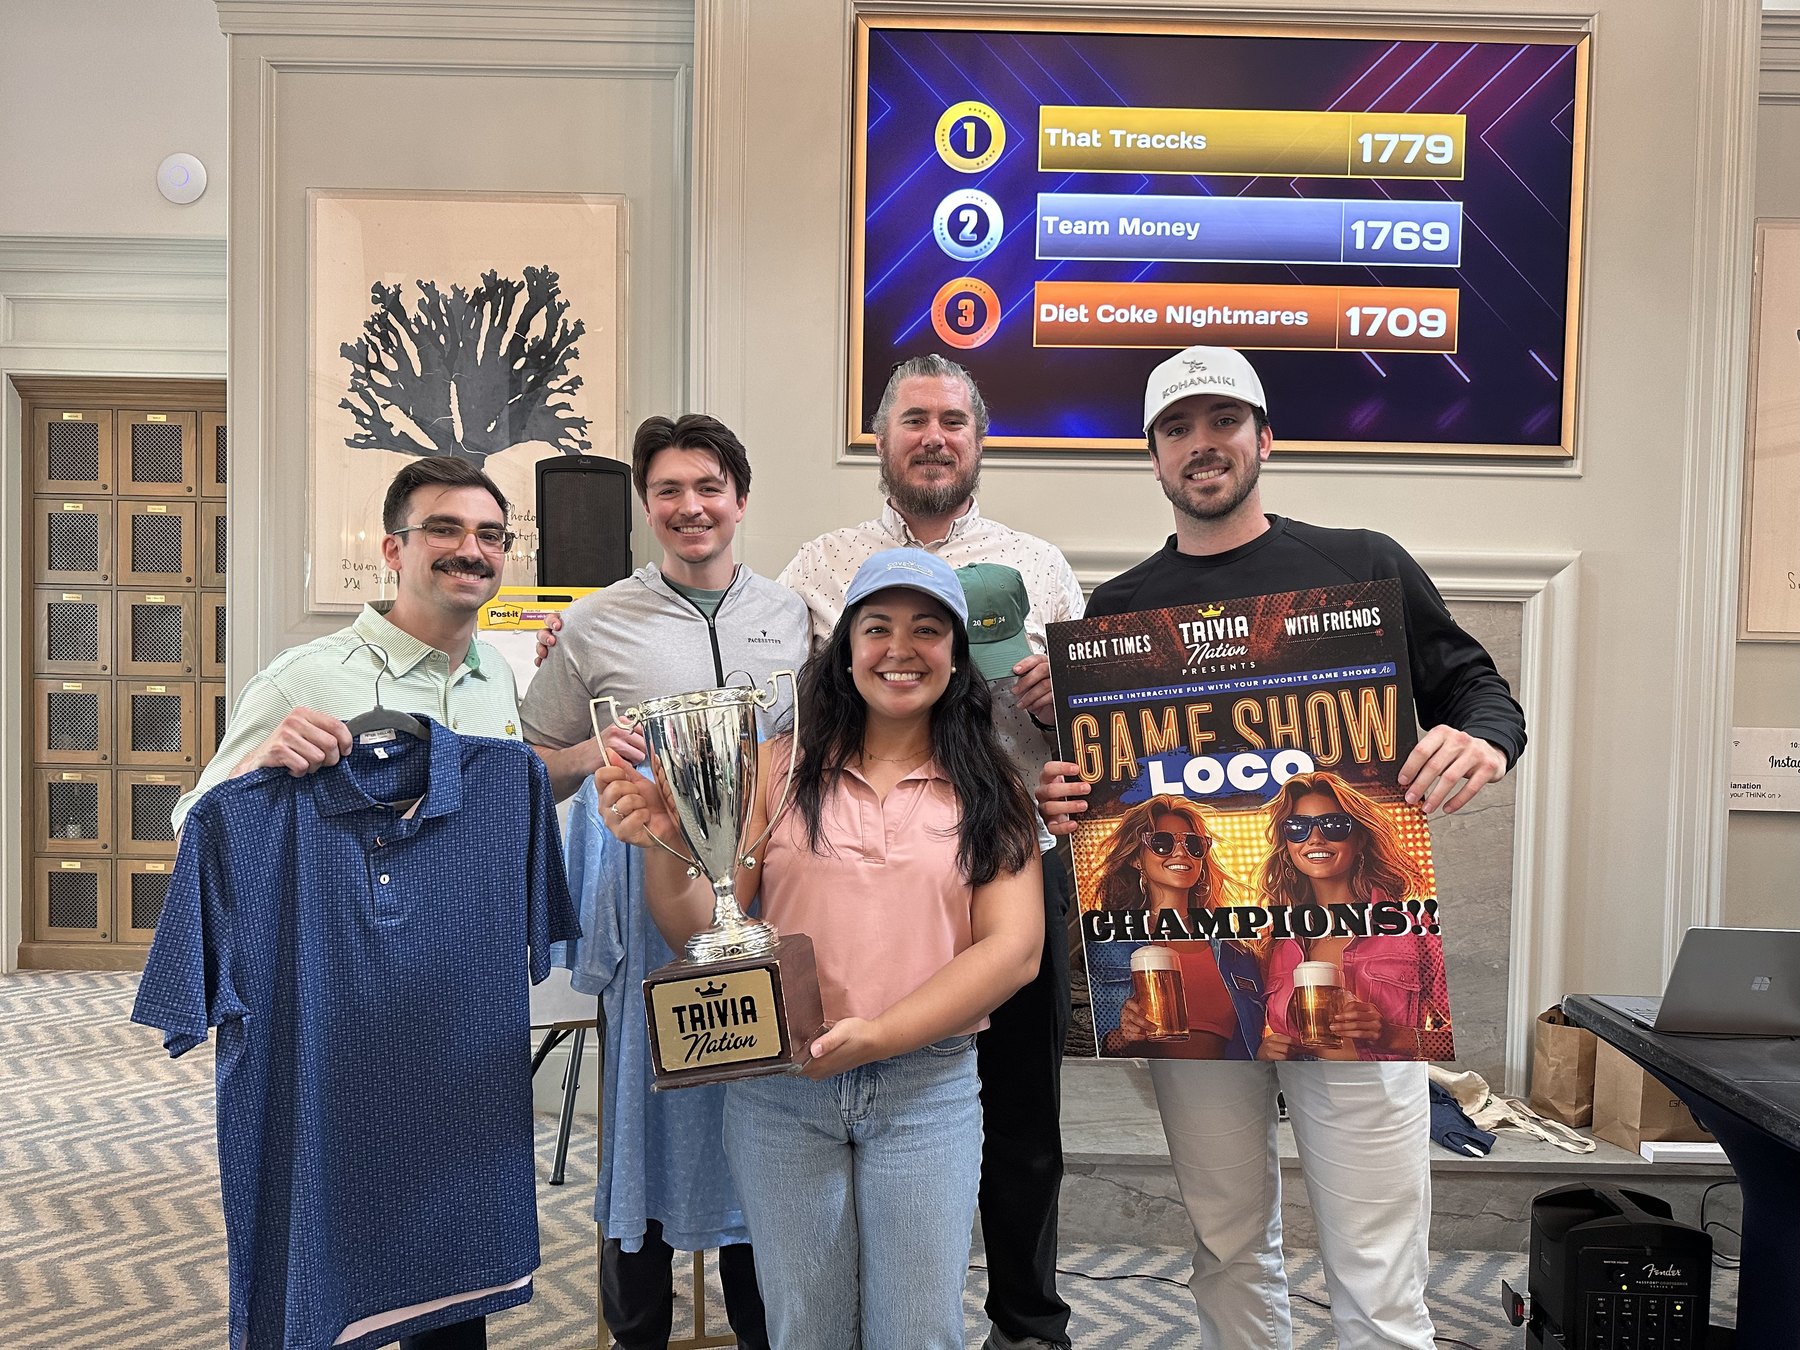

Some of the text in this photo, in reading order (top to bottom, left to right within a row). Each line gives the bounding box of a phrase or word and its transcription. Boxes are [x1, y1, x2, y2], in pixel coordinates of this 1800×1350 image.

[963, 121, 976, 153] 1
[1045, 128, 1207, 151] That Traccks
[1357, 133, 1455, 165] 1779
[958, 208, 979, 242] 2
[1042, 216, 1200, 241] Team Money
[1350, 220, 1451, 252] 1769
[957, 298, 975, 329] 3
[1040, 304, 1090, 324] Diet
[1096, 304, 1158, 325] Coke
[1344, 307, 1448, 338] 1709
[1161, 375, 1236, 399] KOHANAIKI
[490, 610, 519, 618] Post-it
[972, 619, 982, 627] 20
[1284, 606, 1382, 637] WITH FRIENDS
[1178, 615, 1250, 645] TRIVIA
[1068, 634, 1152, 662] GREAT TIMES
[1185, 642, 1249, 666] Nation
[1181, 661, 1257, 676] PRESENTS
[1072, 666, 1392, 705] EXPERIENCE INTERACTIVE FUN WITH YOUR FAVORITE GAME SHOWS At
[1071, 684, 1398, 784] GAME SHOW
[1148, 749, 1315, 796] LOCO
[1081, 898, 1441, 942] CHAMPIONS!!
[671, 995, 758, 1034] TRIVIA
[681, 1031, 758, 1064] Nation
[1642, 1263, 1682, 1278] Fender
